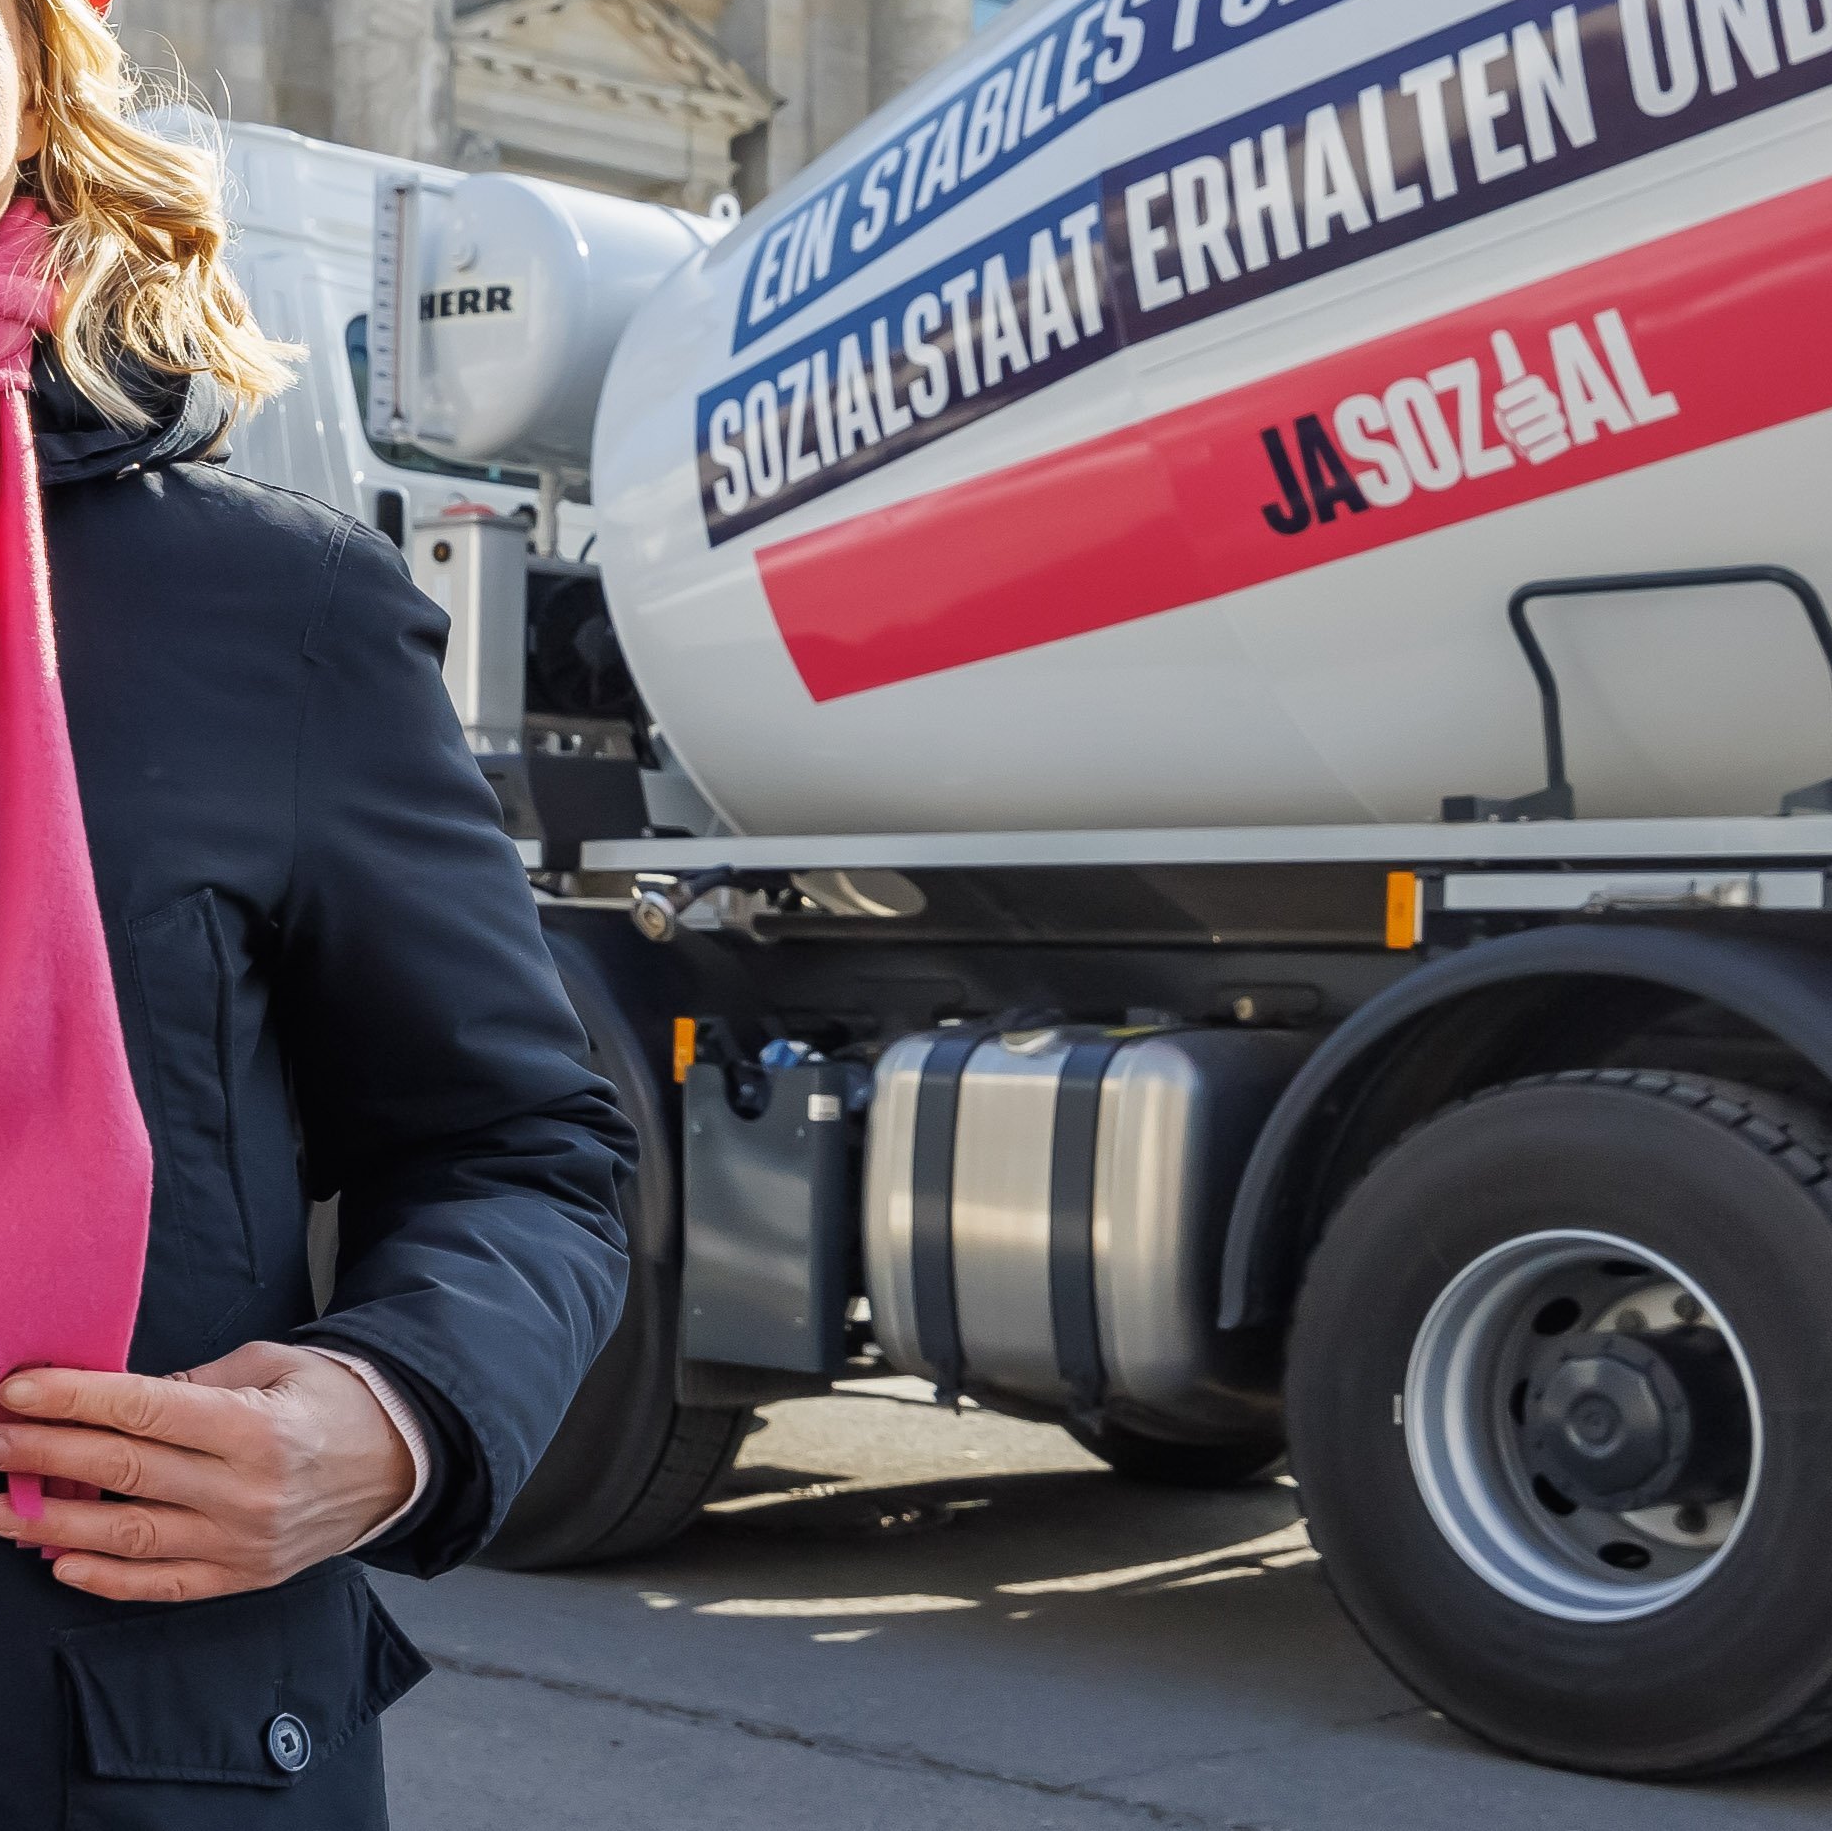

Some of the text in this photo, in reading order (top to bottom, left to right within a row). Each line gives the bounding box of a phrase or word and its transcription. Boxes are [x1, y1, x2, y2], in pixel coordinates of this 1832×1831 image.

[707, 201, 1105, 518] SOZIALSTAAT
[1125, 3, 1597, 313] ERHALTEN
[748, 181, 847, 327] EIN
